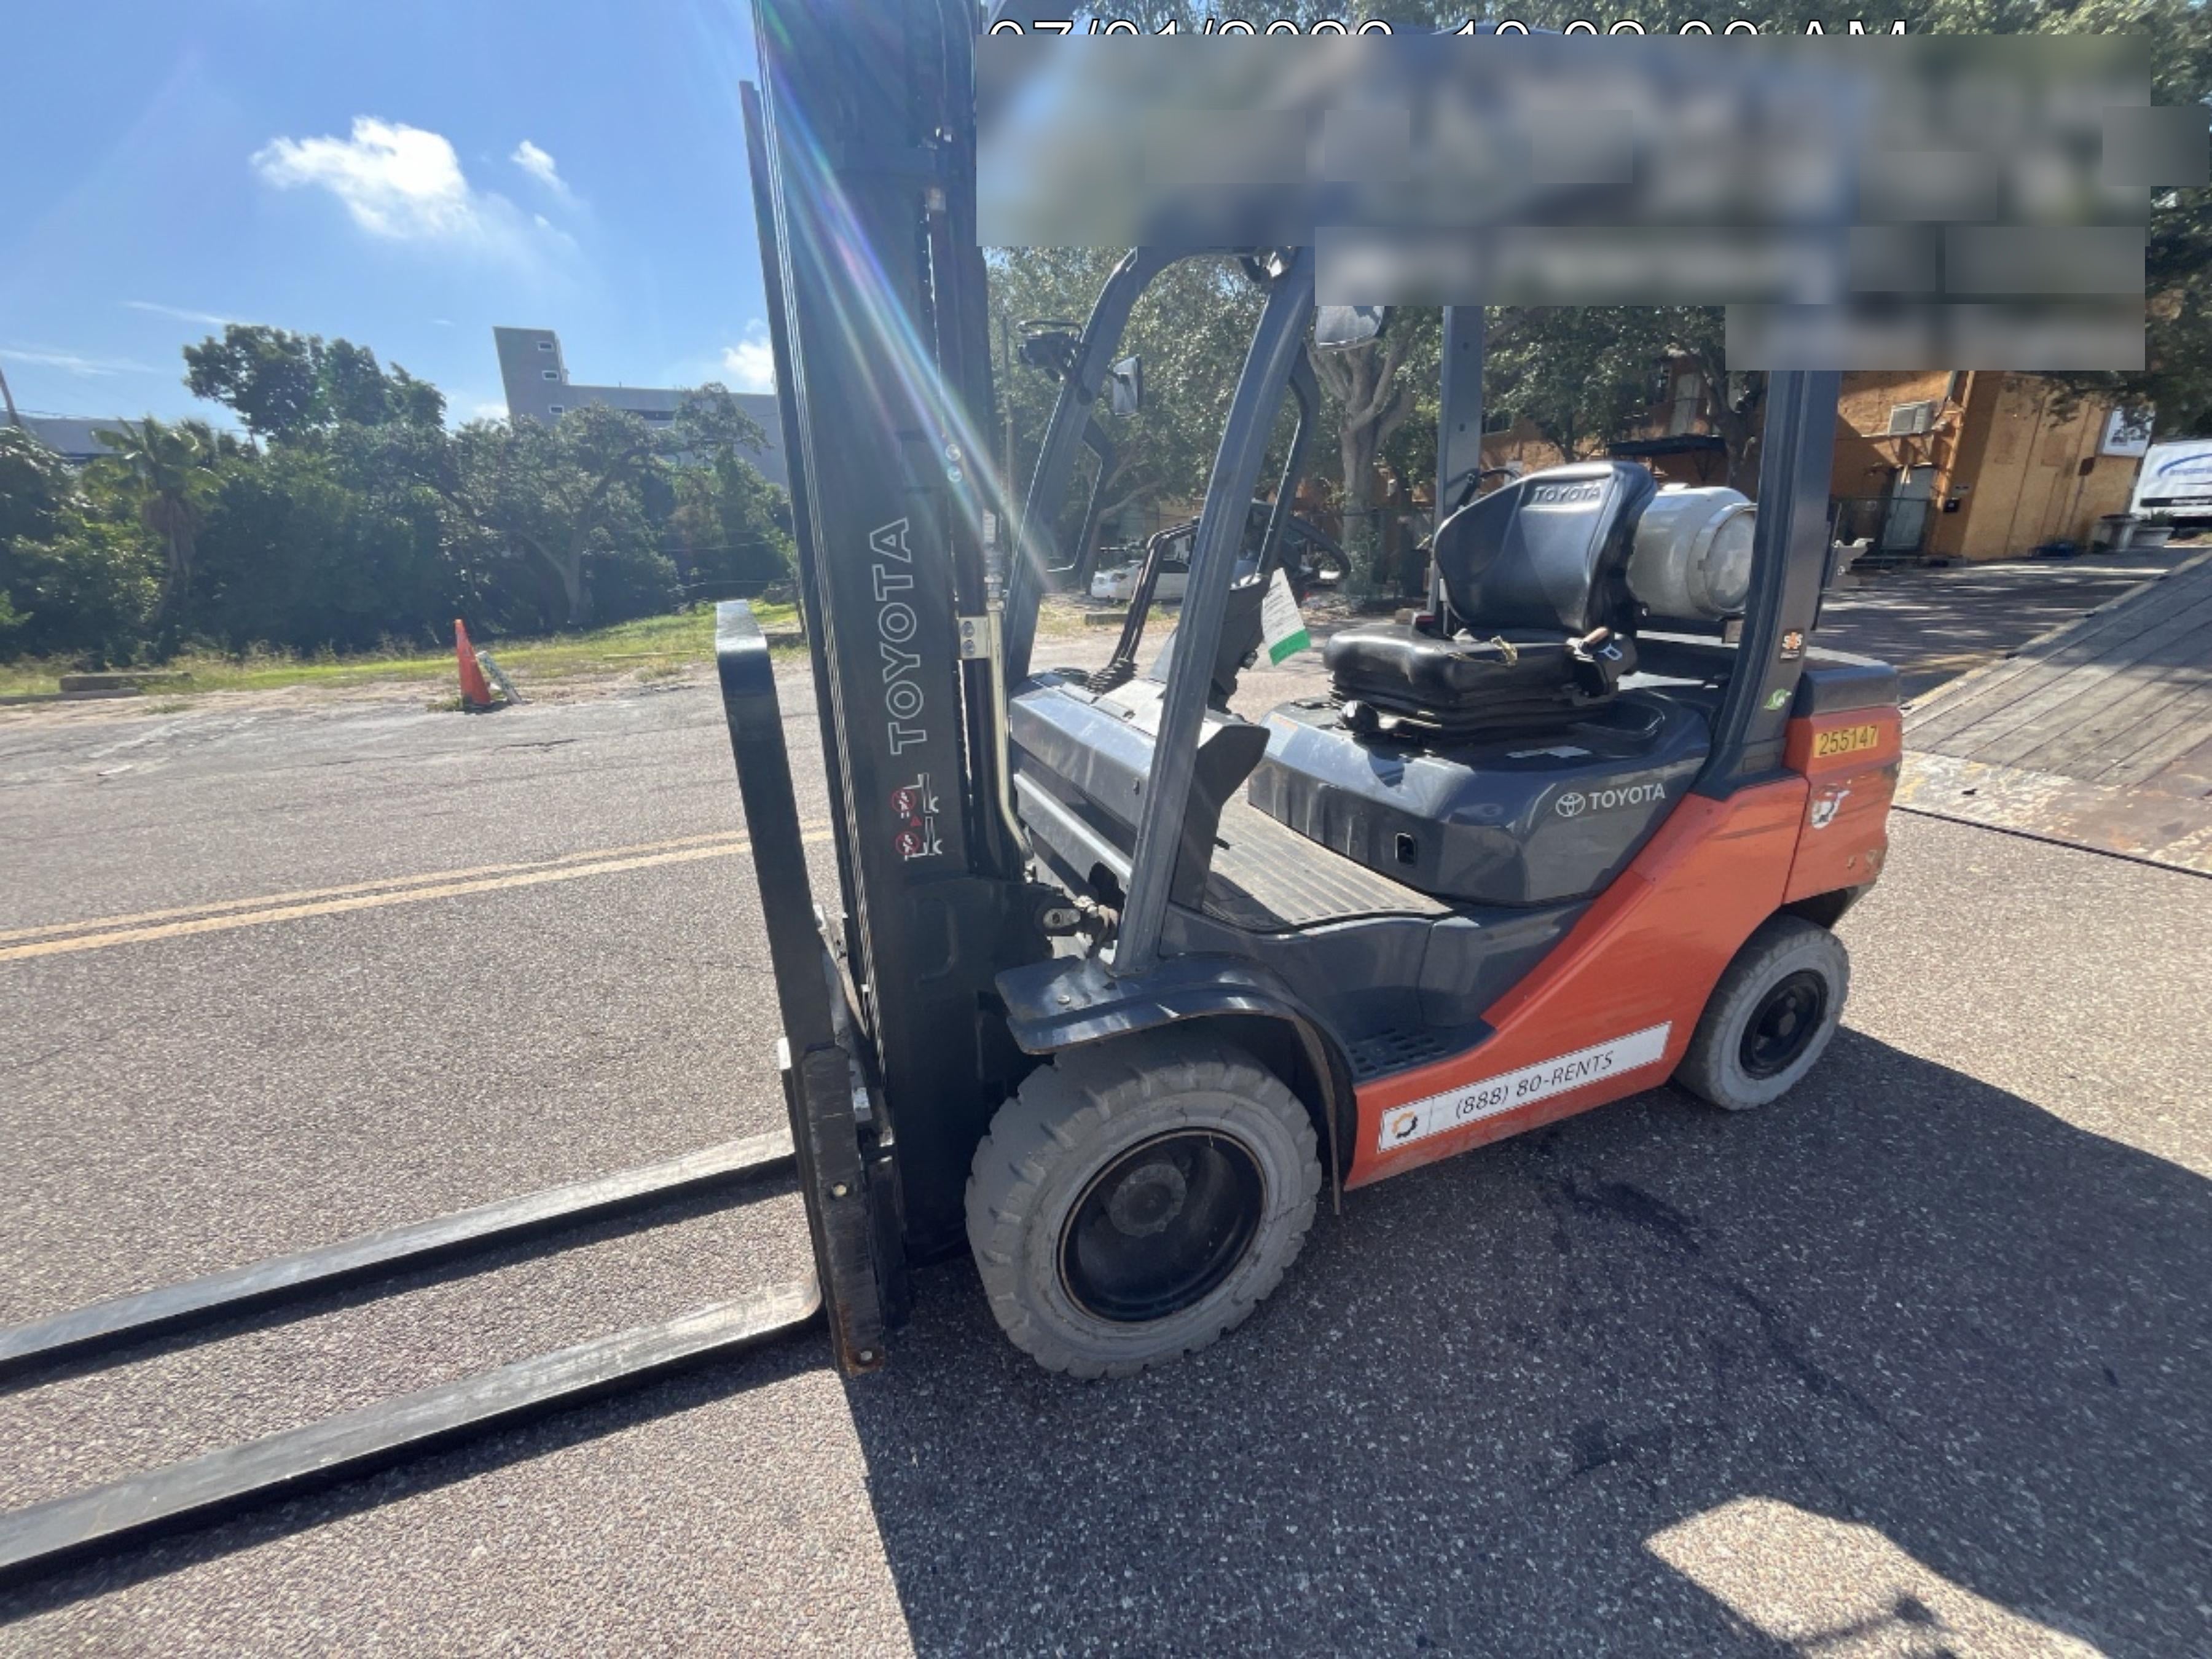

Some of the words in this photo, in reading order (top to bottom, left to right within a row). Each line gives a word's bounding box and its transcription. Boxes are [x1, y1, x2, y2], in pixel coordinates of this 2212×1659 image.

[1535, 482, 1601, 501] TOYOTA
[869, 517, 928, 756] TOYOTA
[1819, 724, 1877, 756] 255147
[1588, 783, 1666, 810] TOYOTA
[1456, 1085, 1508, 1120] (888)
[1516, 1050, 1614, 1097] 80-RENTS
